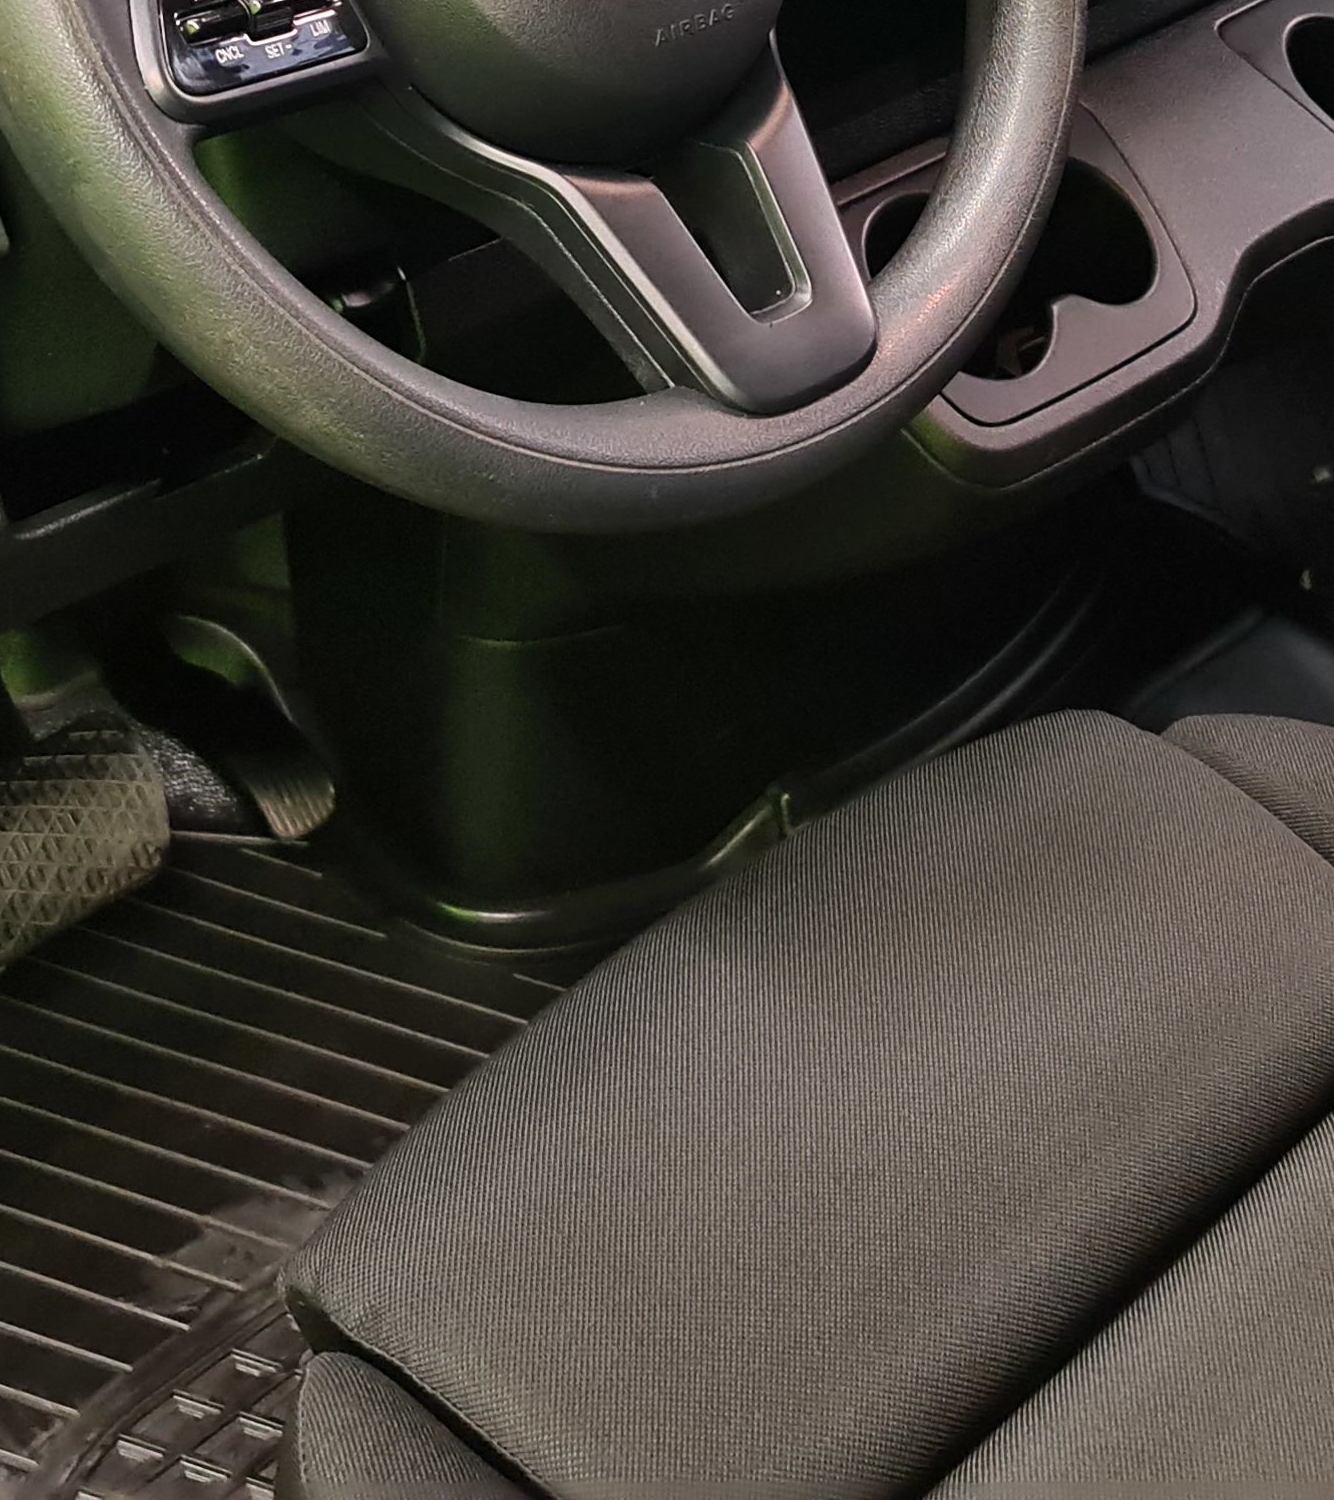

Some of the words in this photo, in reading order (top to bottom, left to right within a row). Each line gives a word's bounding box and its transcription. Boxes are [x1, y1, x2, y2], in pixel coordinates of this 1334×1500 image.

[310, 19, 331, 37] LIM
[655, 3, 735, 47] AIRBAG
[215, 46, 244, 64] CNCL
